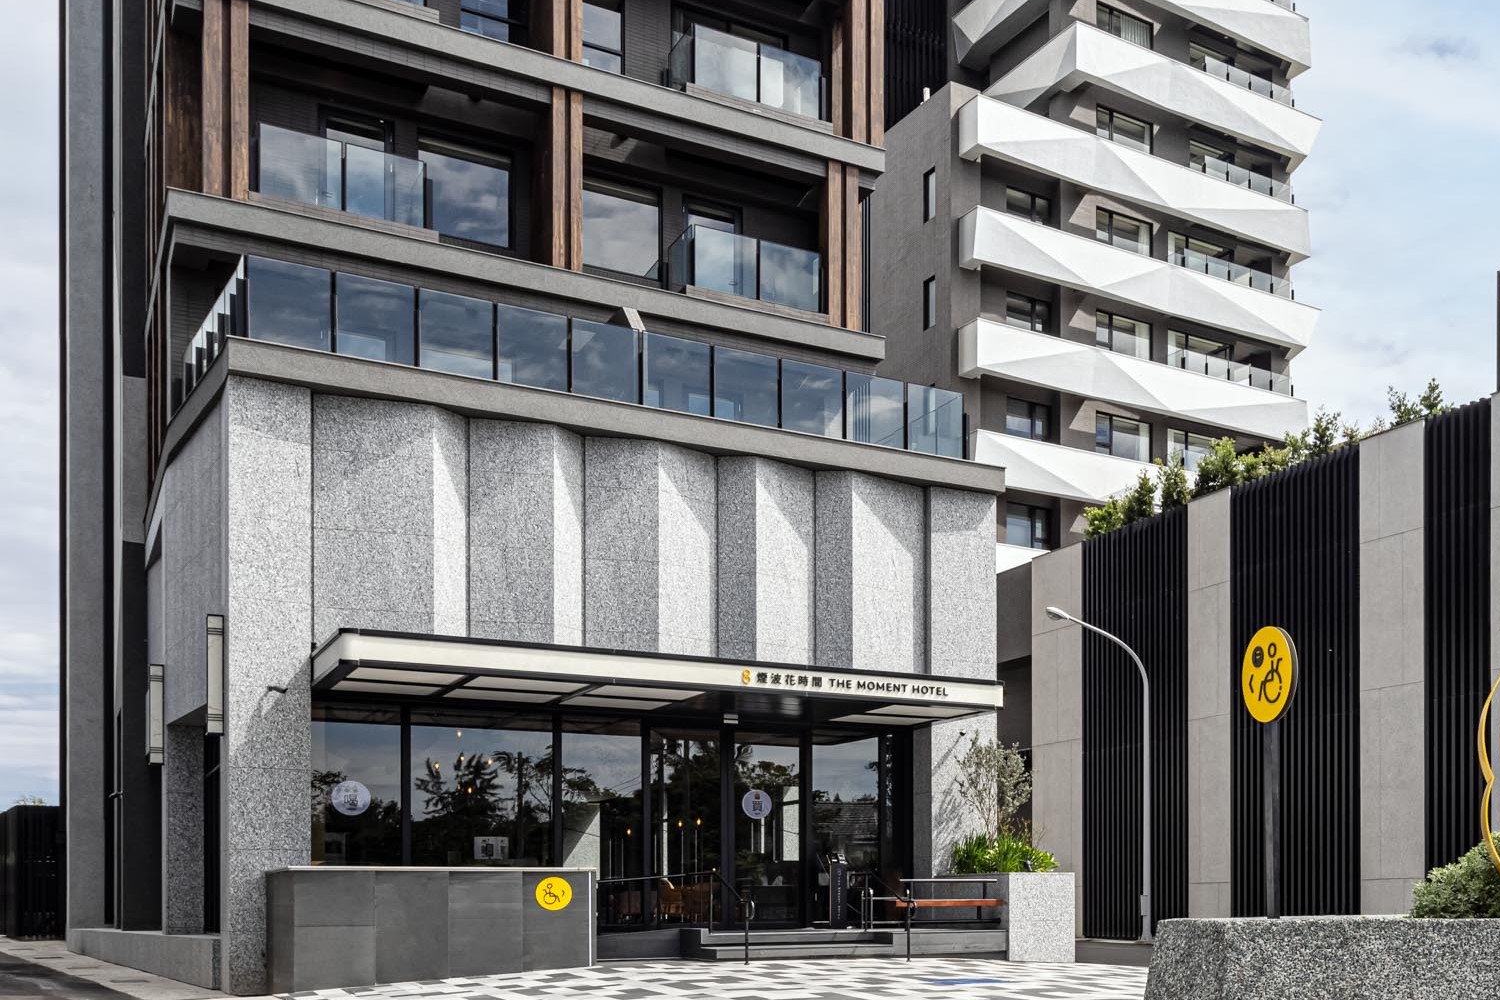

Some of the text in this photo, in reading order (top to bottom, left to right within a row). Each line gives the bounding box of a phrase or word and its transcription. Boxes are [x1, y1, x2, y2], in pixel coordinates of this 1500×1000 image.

[756, 671, 823, 688] 煙波花時間
[829, 678, 949, 697] THE MOMENT HOTEL
